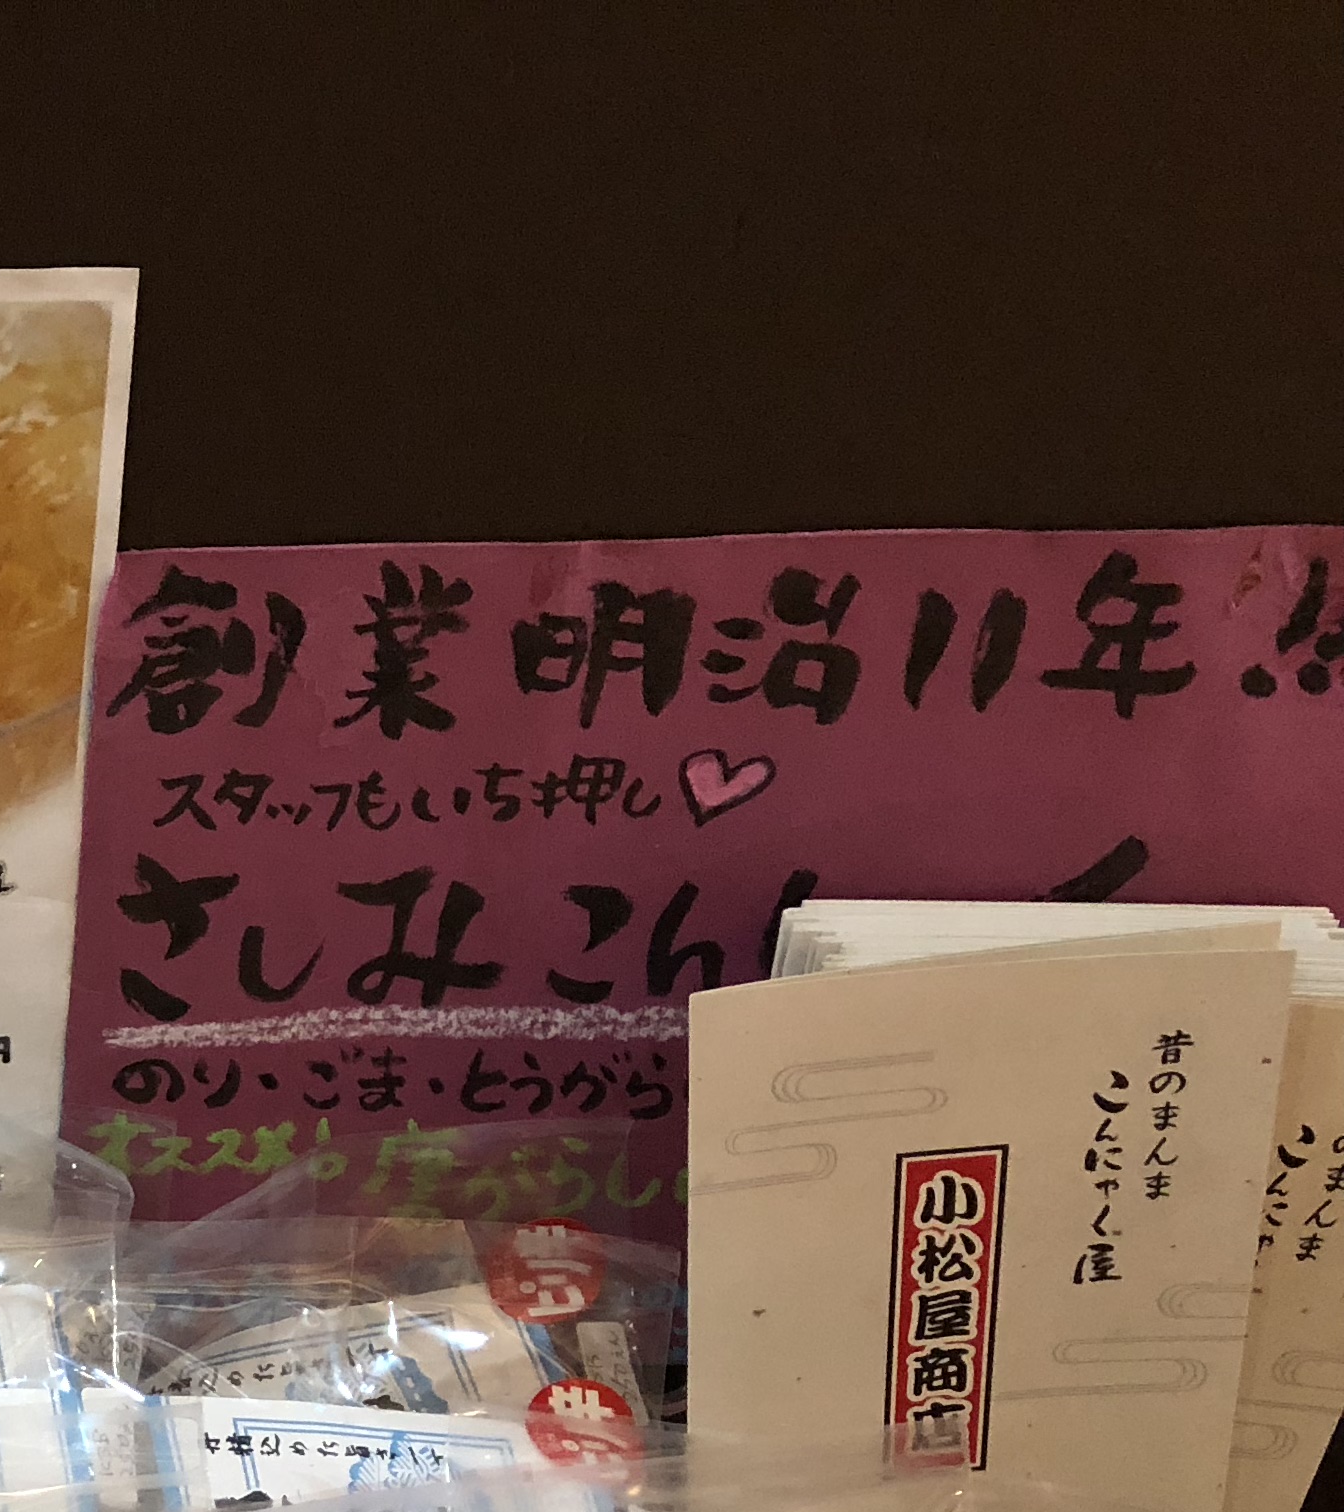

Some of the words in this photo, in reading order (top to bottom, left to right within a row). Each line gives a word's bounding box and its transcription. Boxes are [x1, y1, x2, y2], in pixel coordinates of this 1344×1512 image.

[1073, 1070, 1132, 1285] こんにゃく屋
[1147, 1030, 1196, 1201] 昔のまんま
